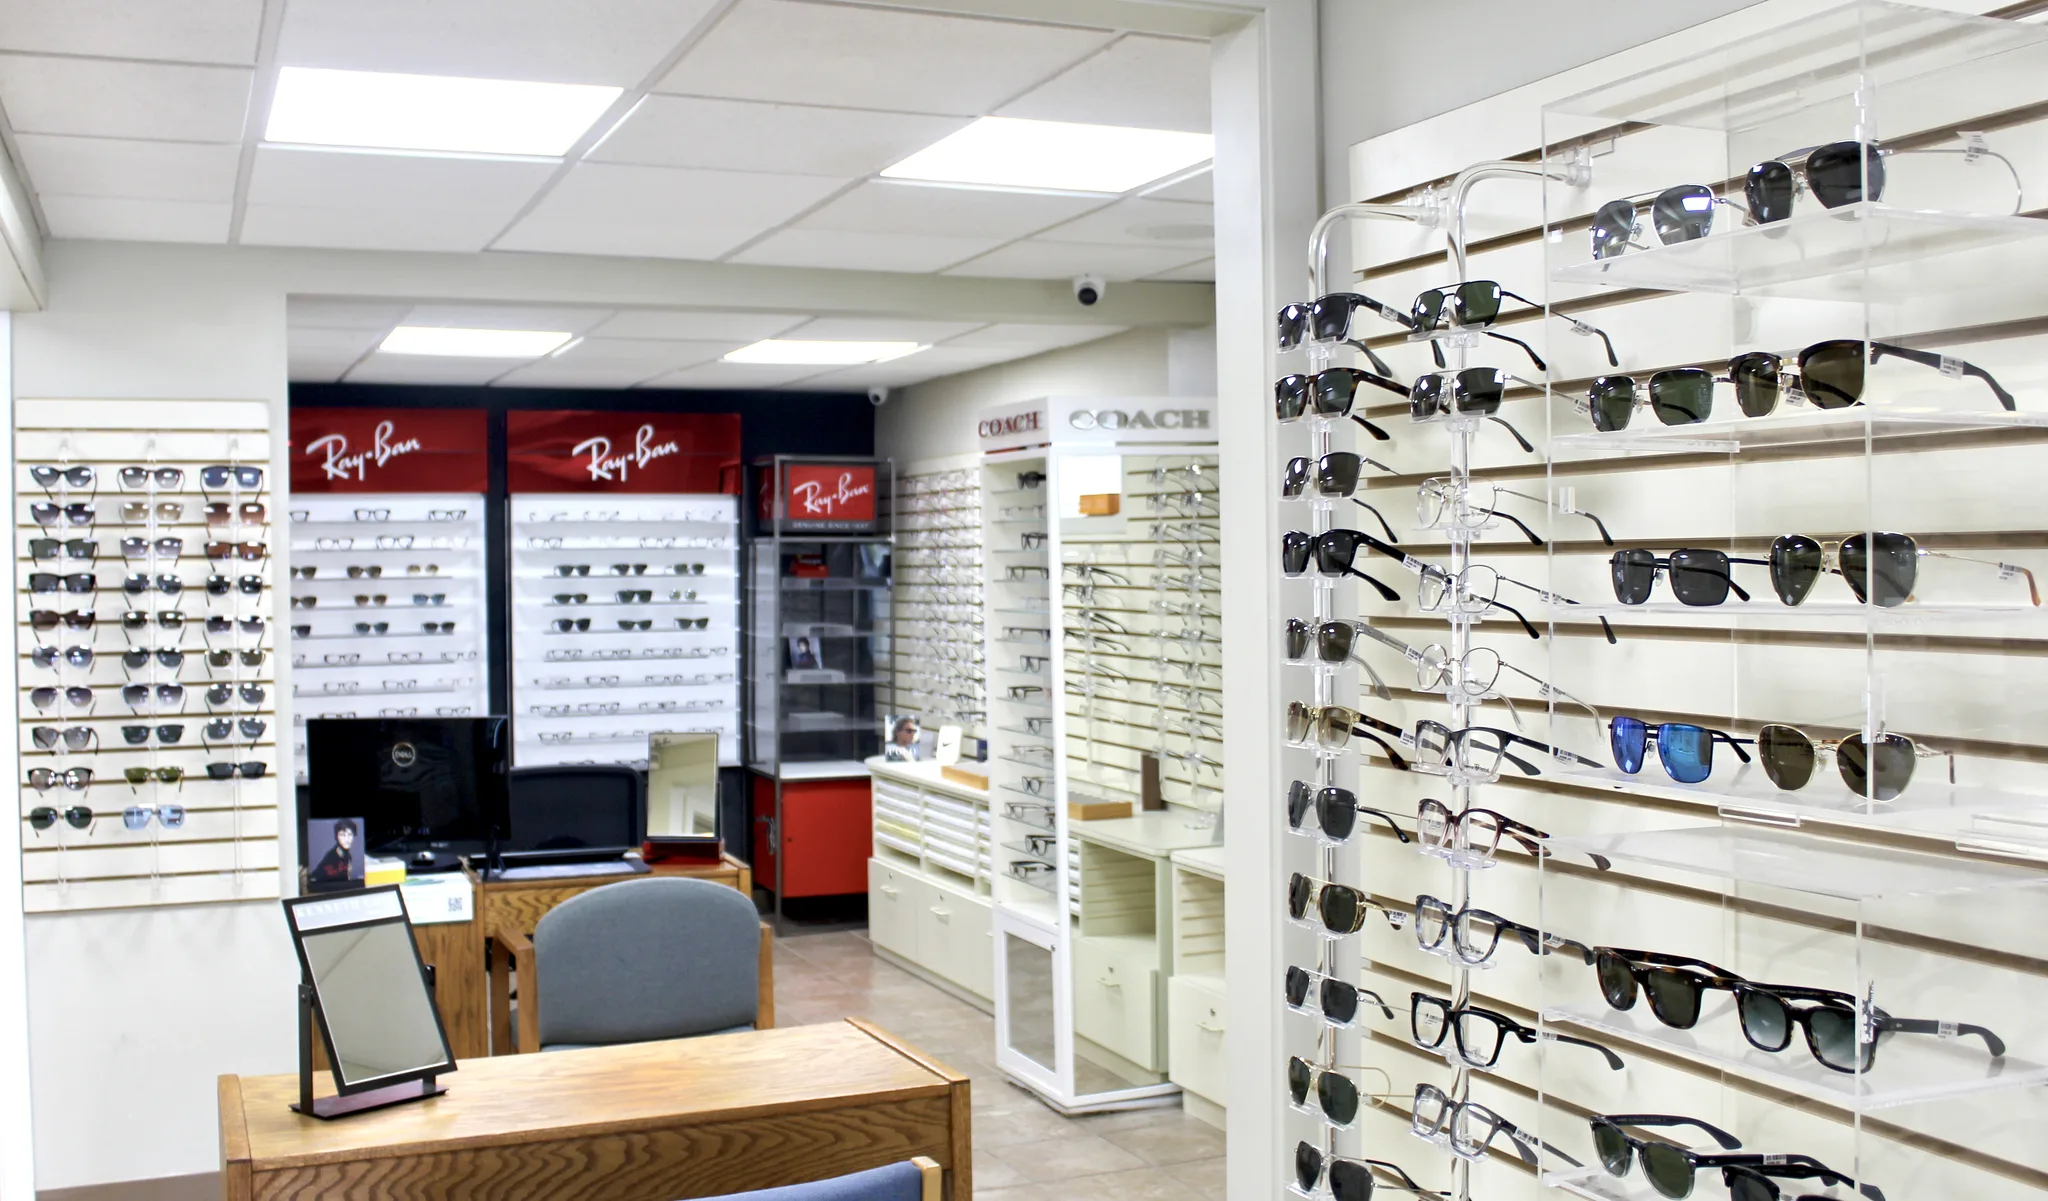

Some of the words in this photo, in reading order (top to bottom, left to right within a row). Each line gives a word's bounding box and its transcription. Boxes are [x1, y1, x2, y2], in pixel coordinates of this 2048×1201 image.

[978, 410, 1039, 438] COACH
[1069, 409, 1210, 431] COACH
[305, 420, 421, 481] Ray-Ban
[571, 423, 679, 482] Ray-Ban
[793, 472, 870, 514] Ray-Ban
